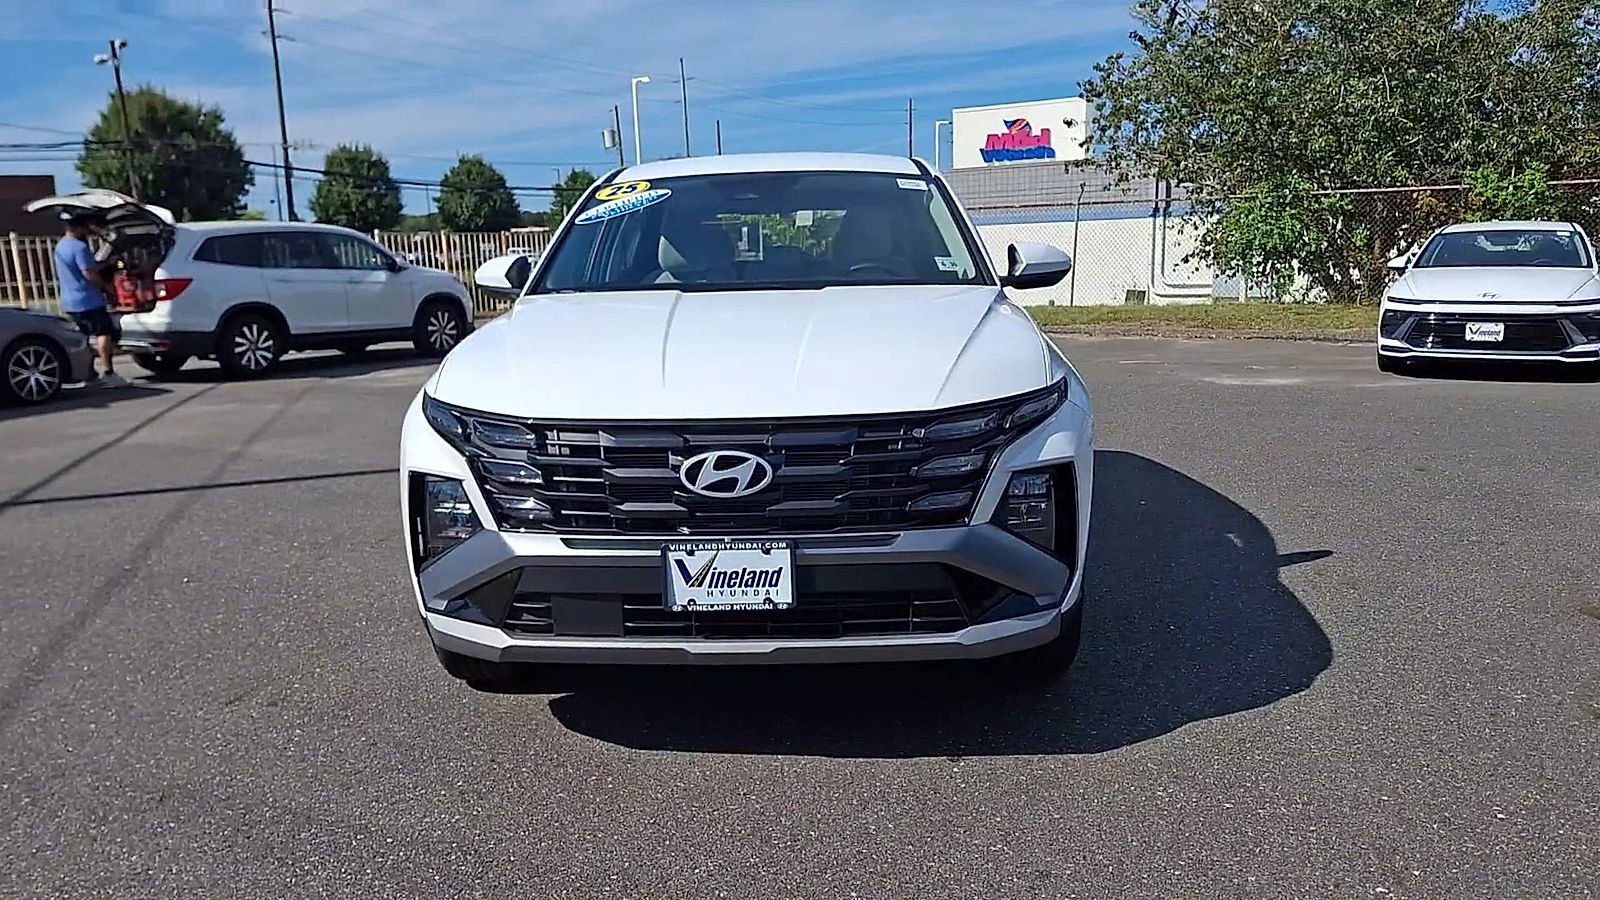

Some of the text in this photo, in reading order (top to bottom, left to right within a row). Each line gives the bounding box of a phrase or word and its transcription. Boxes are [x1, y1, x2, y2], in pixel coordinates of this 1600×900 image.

[605, 183, 640, 198] 25
[668, 542, 787, 551] VINELANDHYUNDAI.COM
[673, 552, 784, 589] Vineland
[706, 589, 779, 597] HYUNDAI
[687, 602, 773, 611] VINELAND HYUNDAI
